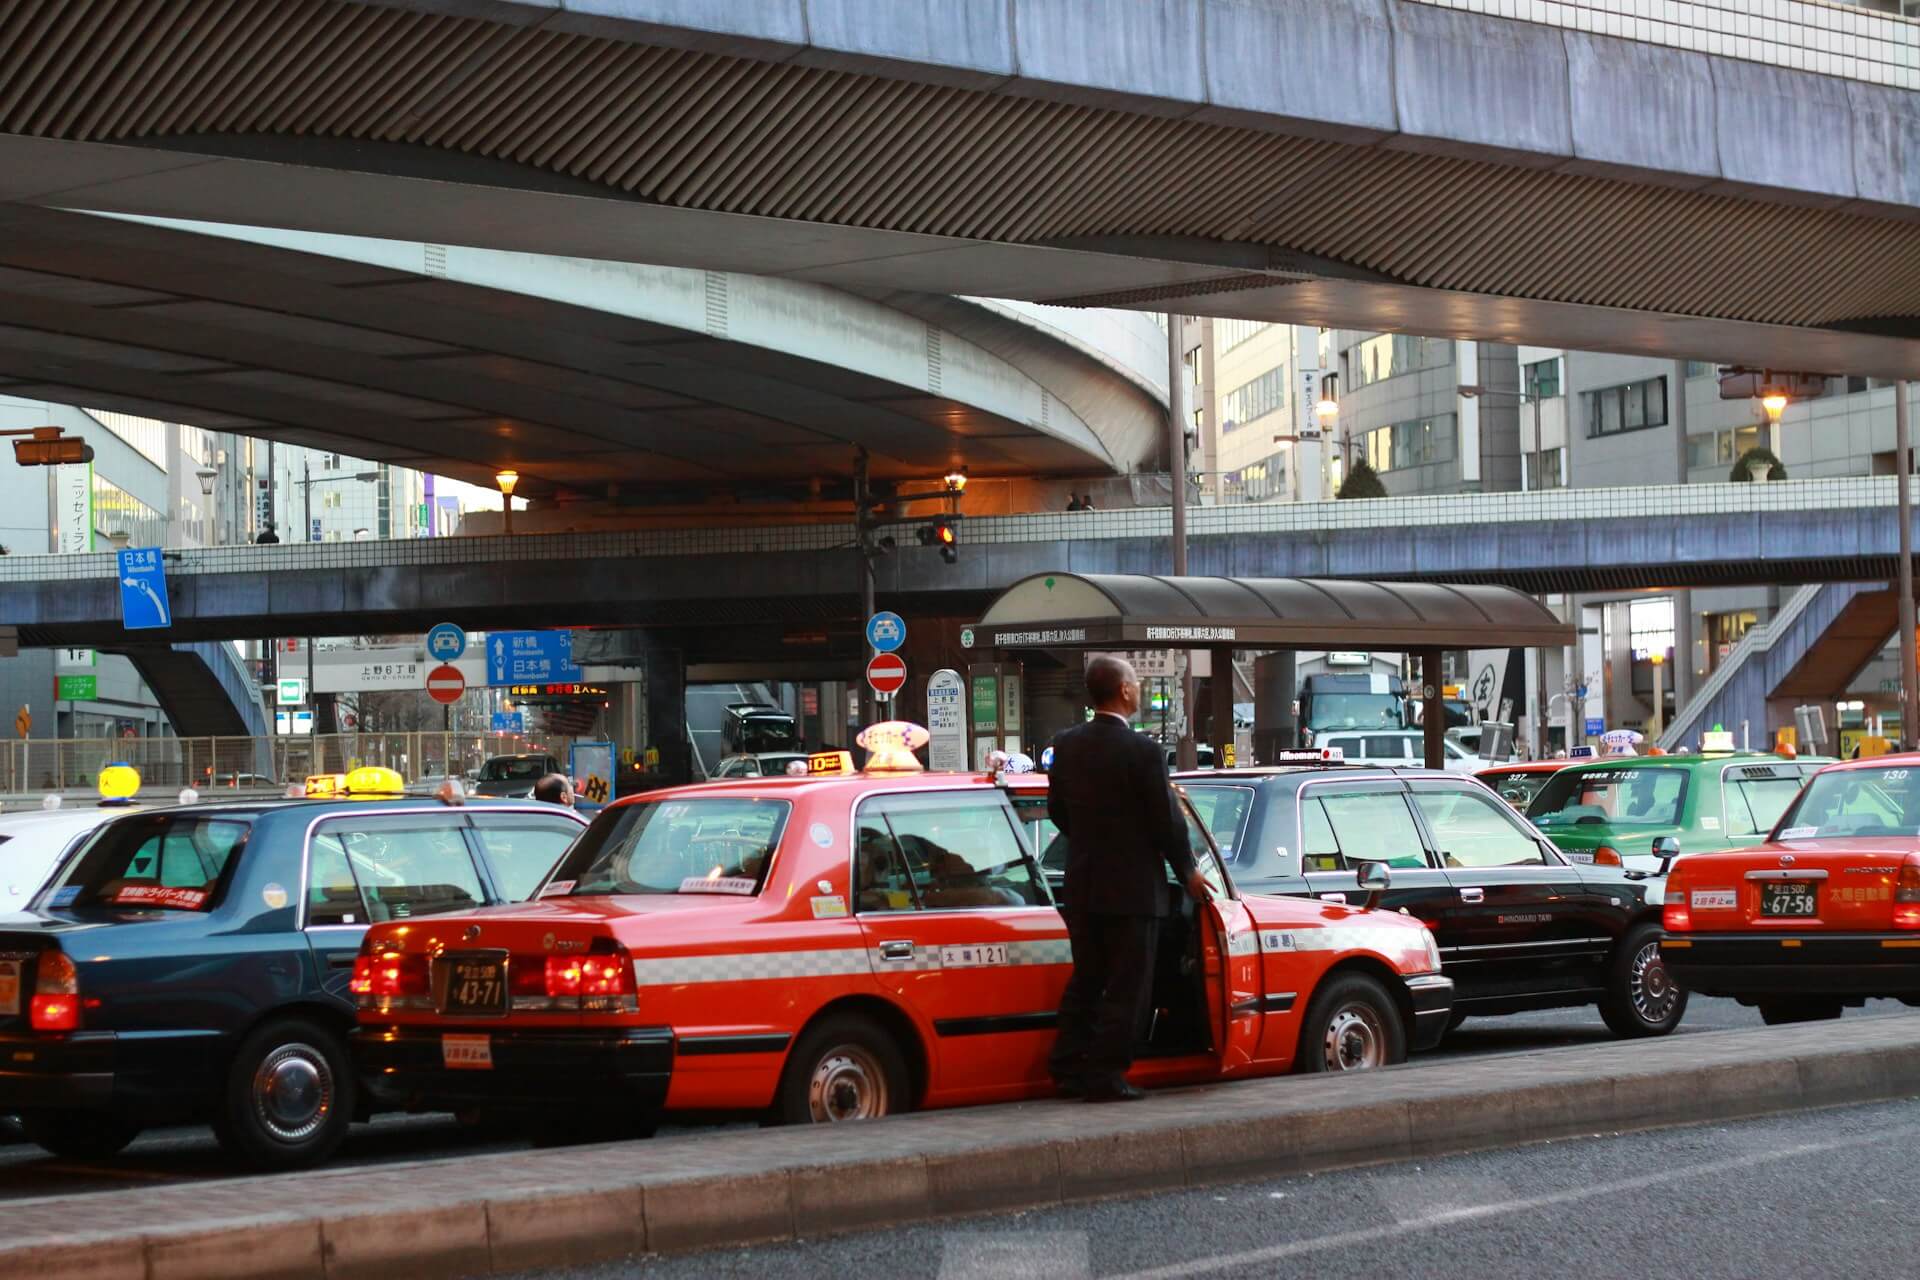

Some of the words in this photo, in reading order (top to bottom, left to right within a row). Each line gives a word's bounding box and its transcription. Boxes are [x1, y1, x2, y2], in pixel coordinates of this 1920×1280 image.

[512, 636, 538, 649] 新橋
[361, 664, 417, 675] 上野6丁目
[513, 659, 551, 672] 日本橋
[1280, 750, 1321, 761] Hinomaru
[1508, 773, 1528, 782] 327
[1612, 771, 1640, 780] 7133
[1883, 769, 1909, 780] 130
[1791, 884, 1806, 893] 500
[1772, 895, 1815, 914] 67-58
[975, 946, 1004, 964] 121
